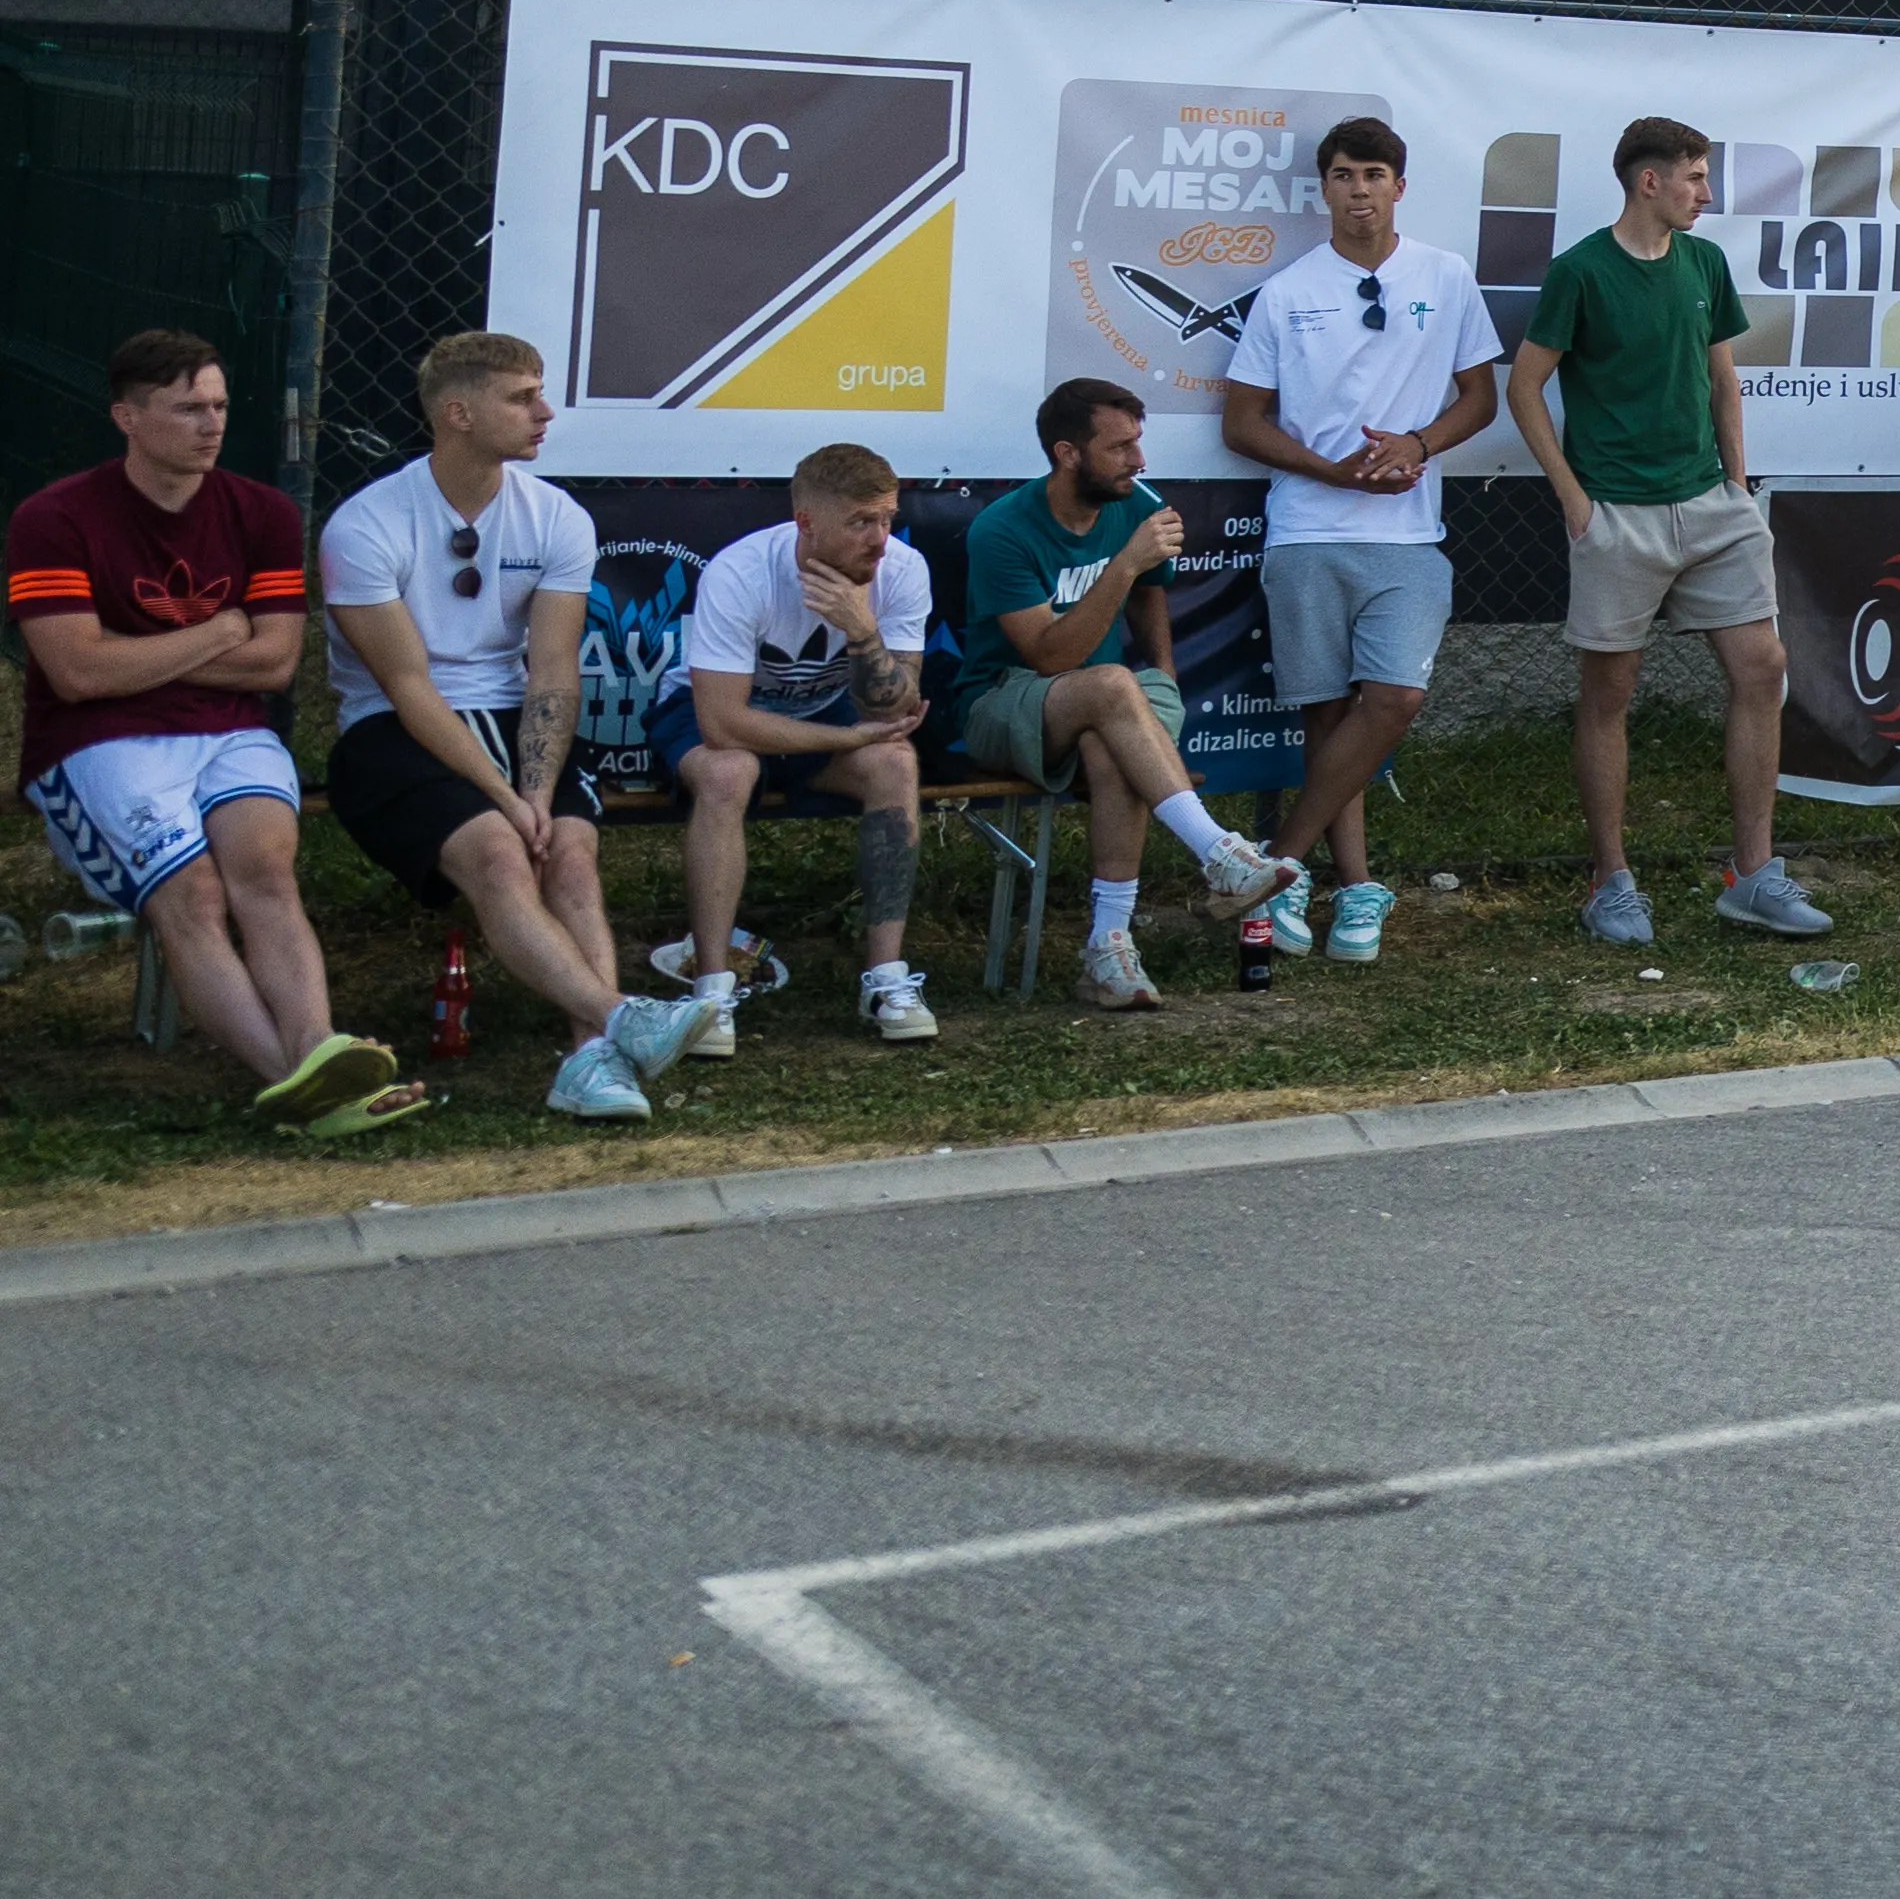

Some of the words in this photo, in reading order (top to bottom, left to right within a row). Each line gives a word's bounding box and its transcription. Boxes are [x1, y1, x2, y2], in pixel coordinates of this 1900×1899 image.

[1180, 103, 1287, 128] mesnica
[590, 114, 791, 199] KDC
[1161, 126, 1296, 172] MOJ
[1114, 168, 1331, 215] MESAR
[1068, 257, 1149, 375] provjerena
[838, 362, 926, 393] grupa
[1174, 368, 1229, 394] hrva
[1737, 372, 1832, 408] ađenje
[1840, 374, 1848, 398] i
[1187, 729, 1276, 753] dizalice
[1283, 727, 1306, 747] to
